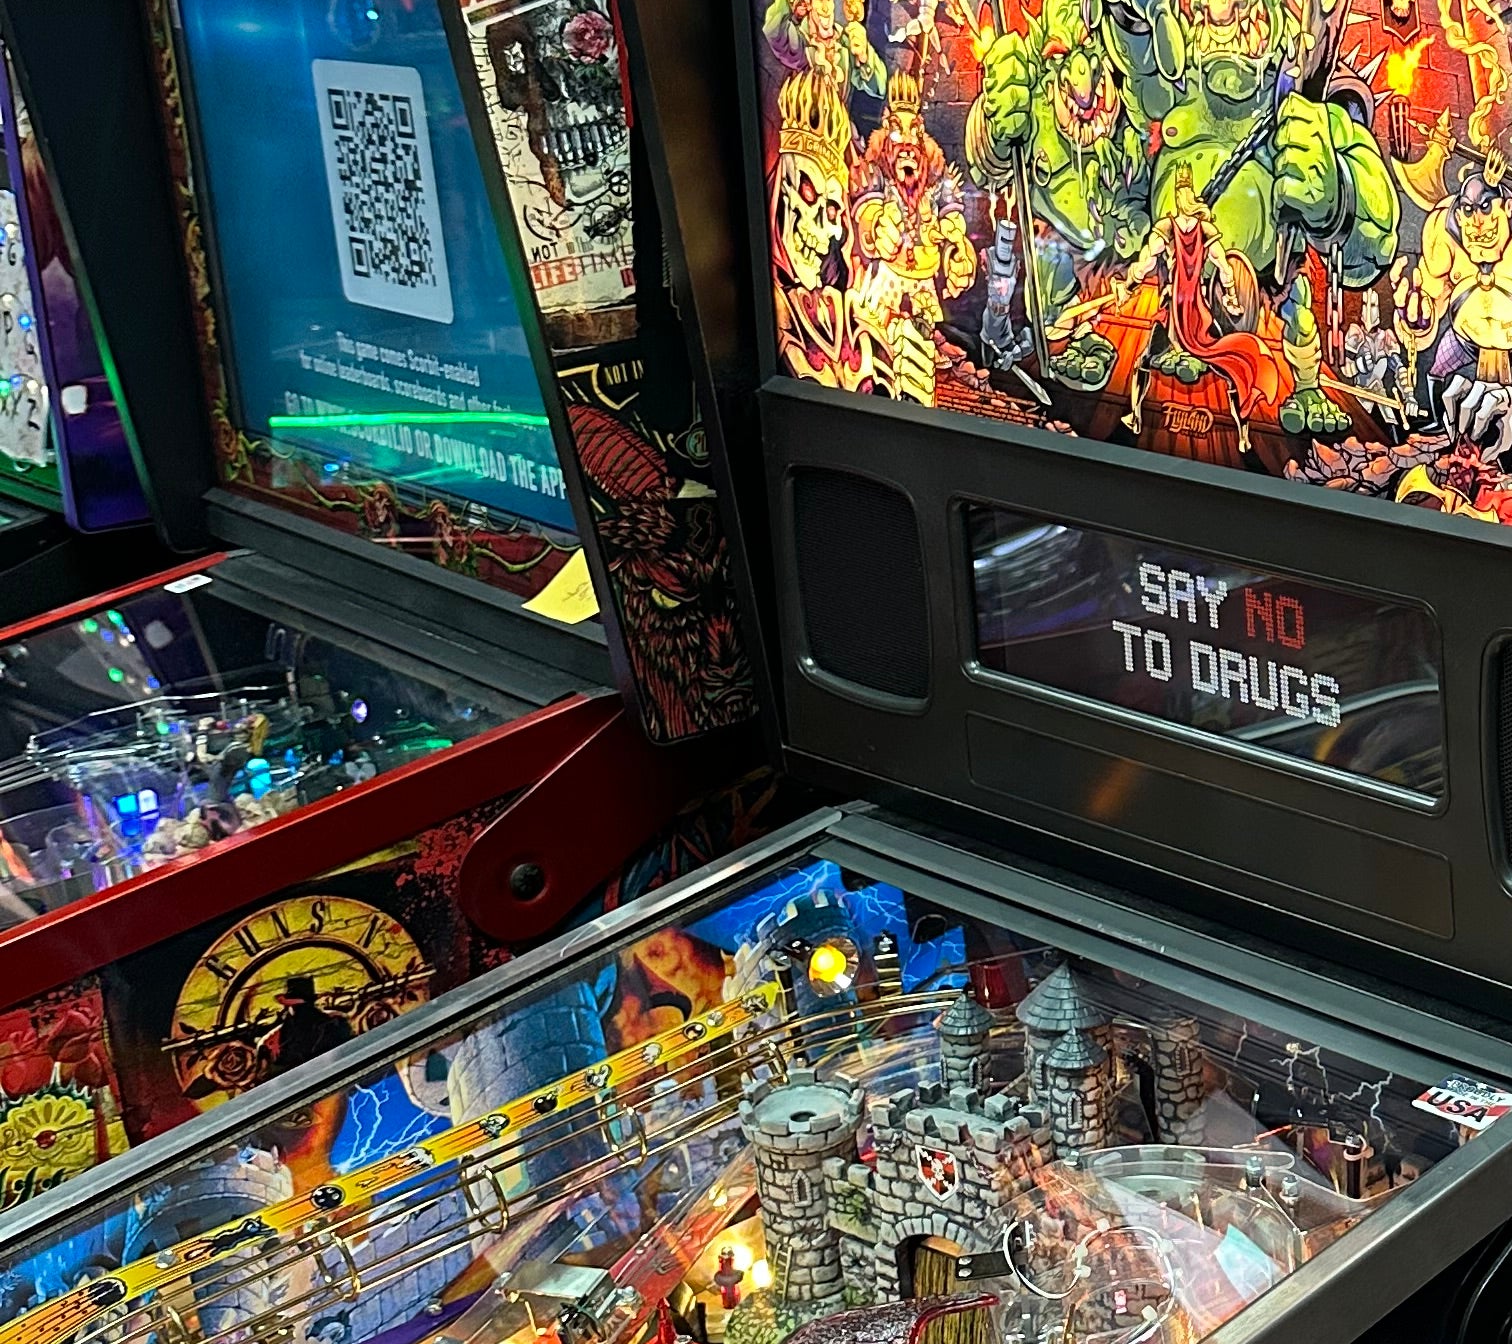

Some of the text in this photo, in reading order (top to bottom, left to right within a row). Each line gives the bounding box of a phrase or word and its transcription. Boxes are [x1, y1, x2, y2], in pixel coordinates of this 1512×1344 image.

[604, 362, 629, 386] NOT
[414, 429, 434, 460] OR
[433, 433, 507, 482] DOWNLOAD
[508, 455, 538, 492] THE
[1139, 561, 1306, 650] SAY NO
[1112, 619, 1342, 728] TO DRUGS
[1426, 1090, 1489, 1123] USA
